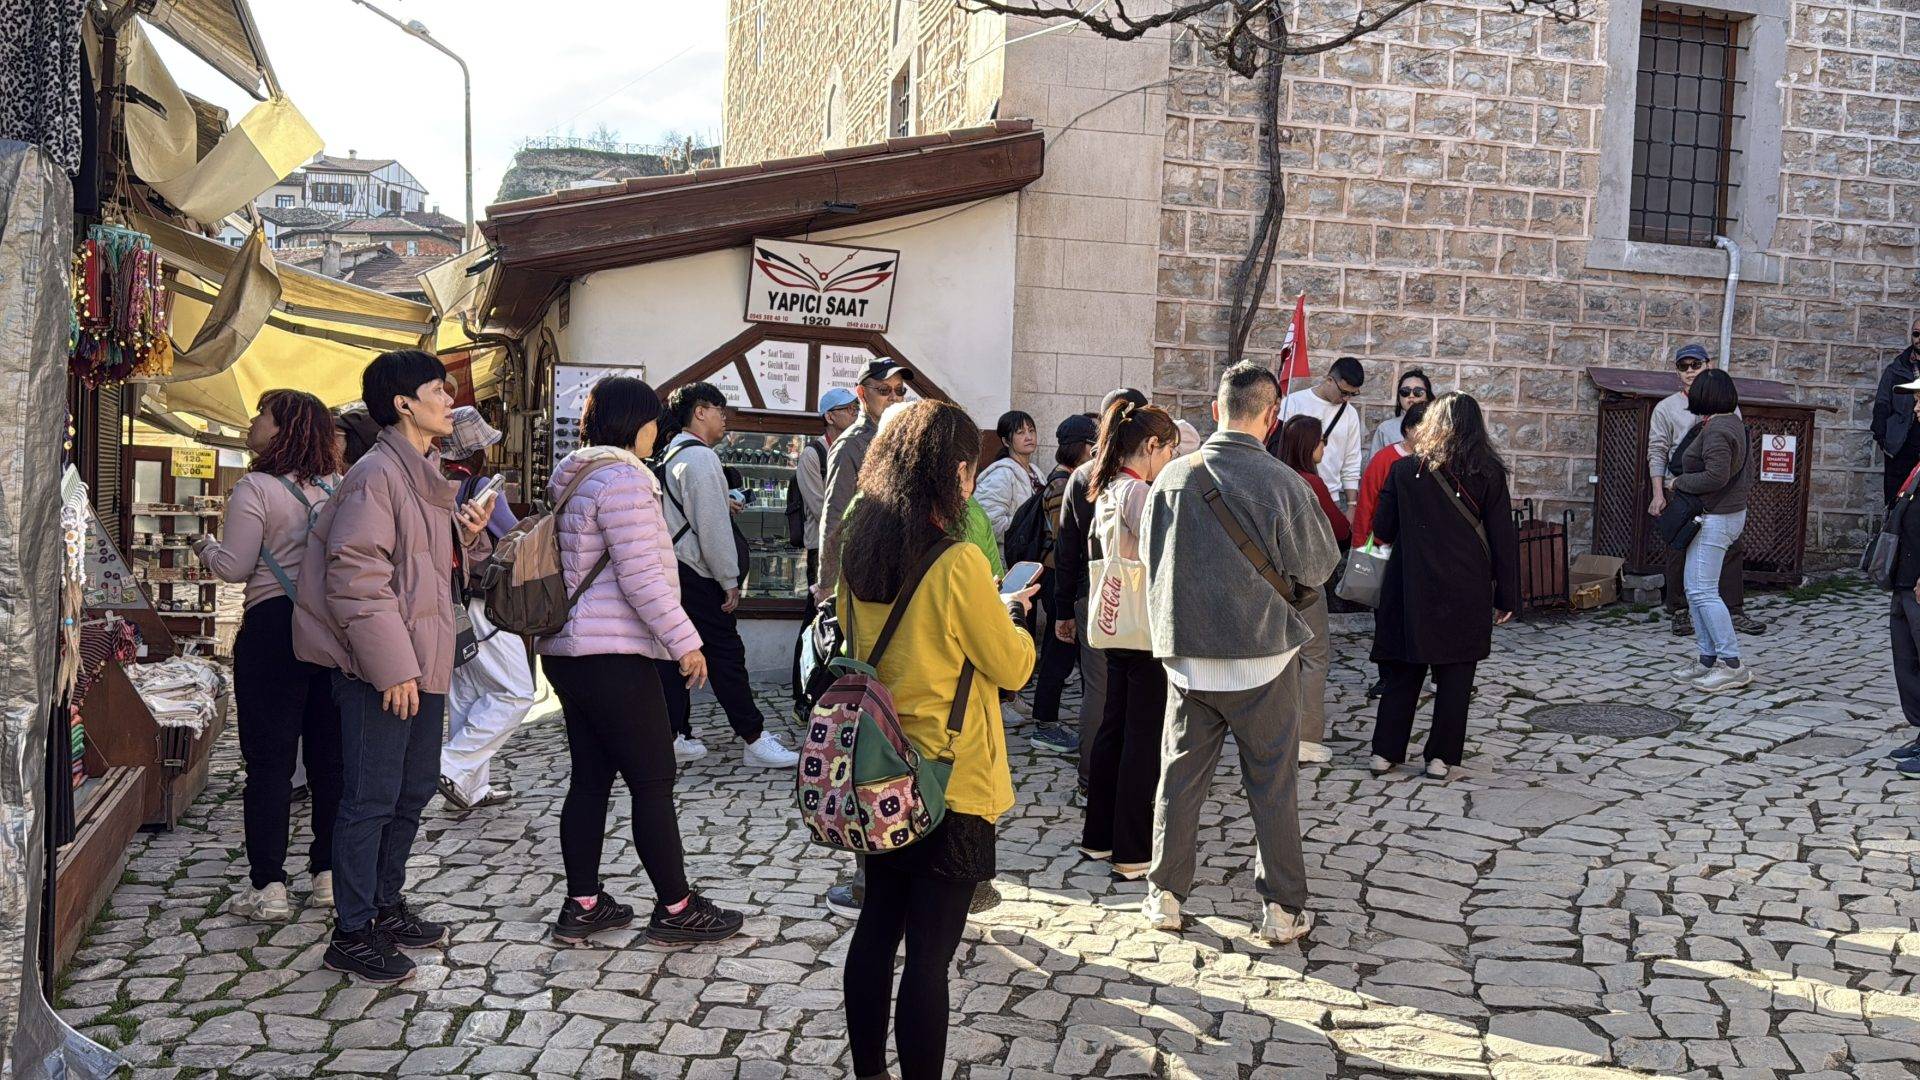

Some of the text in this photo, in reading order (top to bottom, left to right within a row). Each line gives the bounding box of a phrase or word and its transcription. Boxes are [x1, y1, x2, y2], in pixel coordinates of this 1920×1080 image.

[768, 291, 868, 317] YAPICI SAAT
[802, 316, 830, 326] 1920
